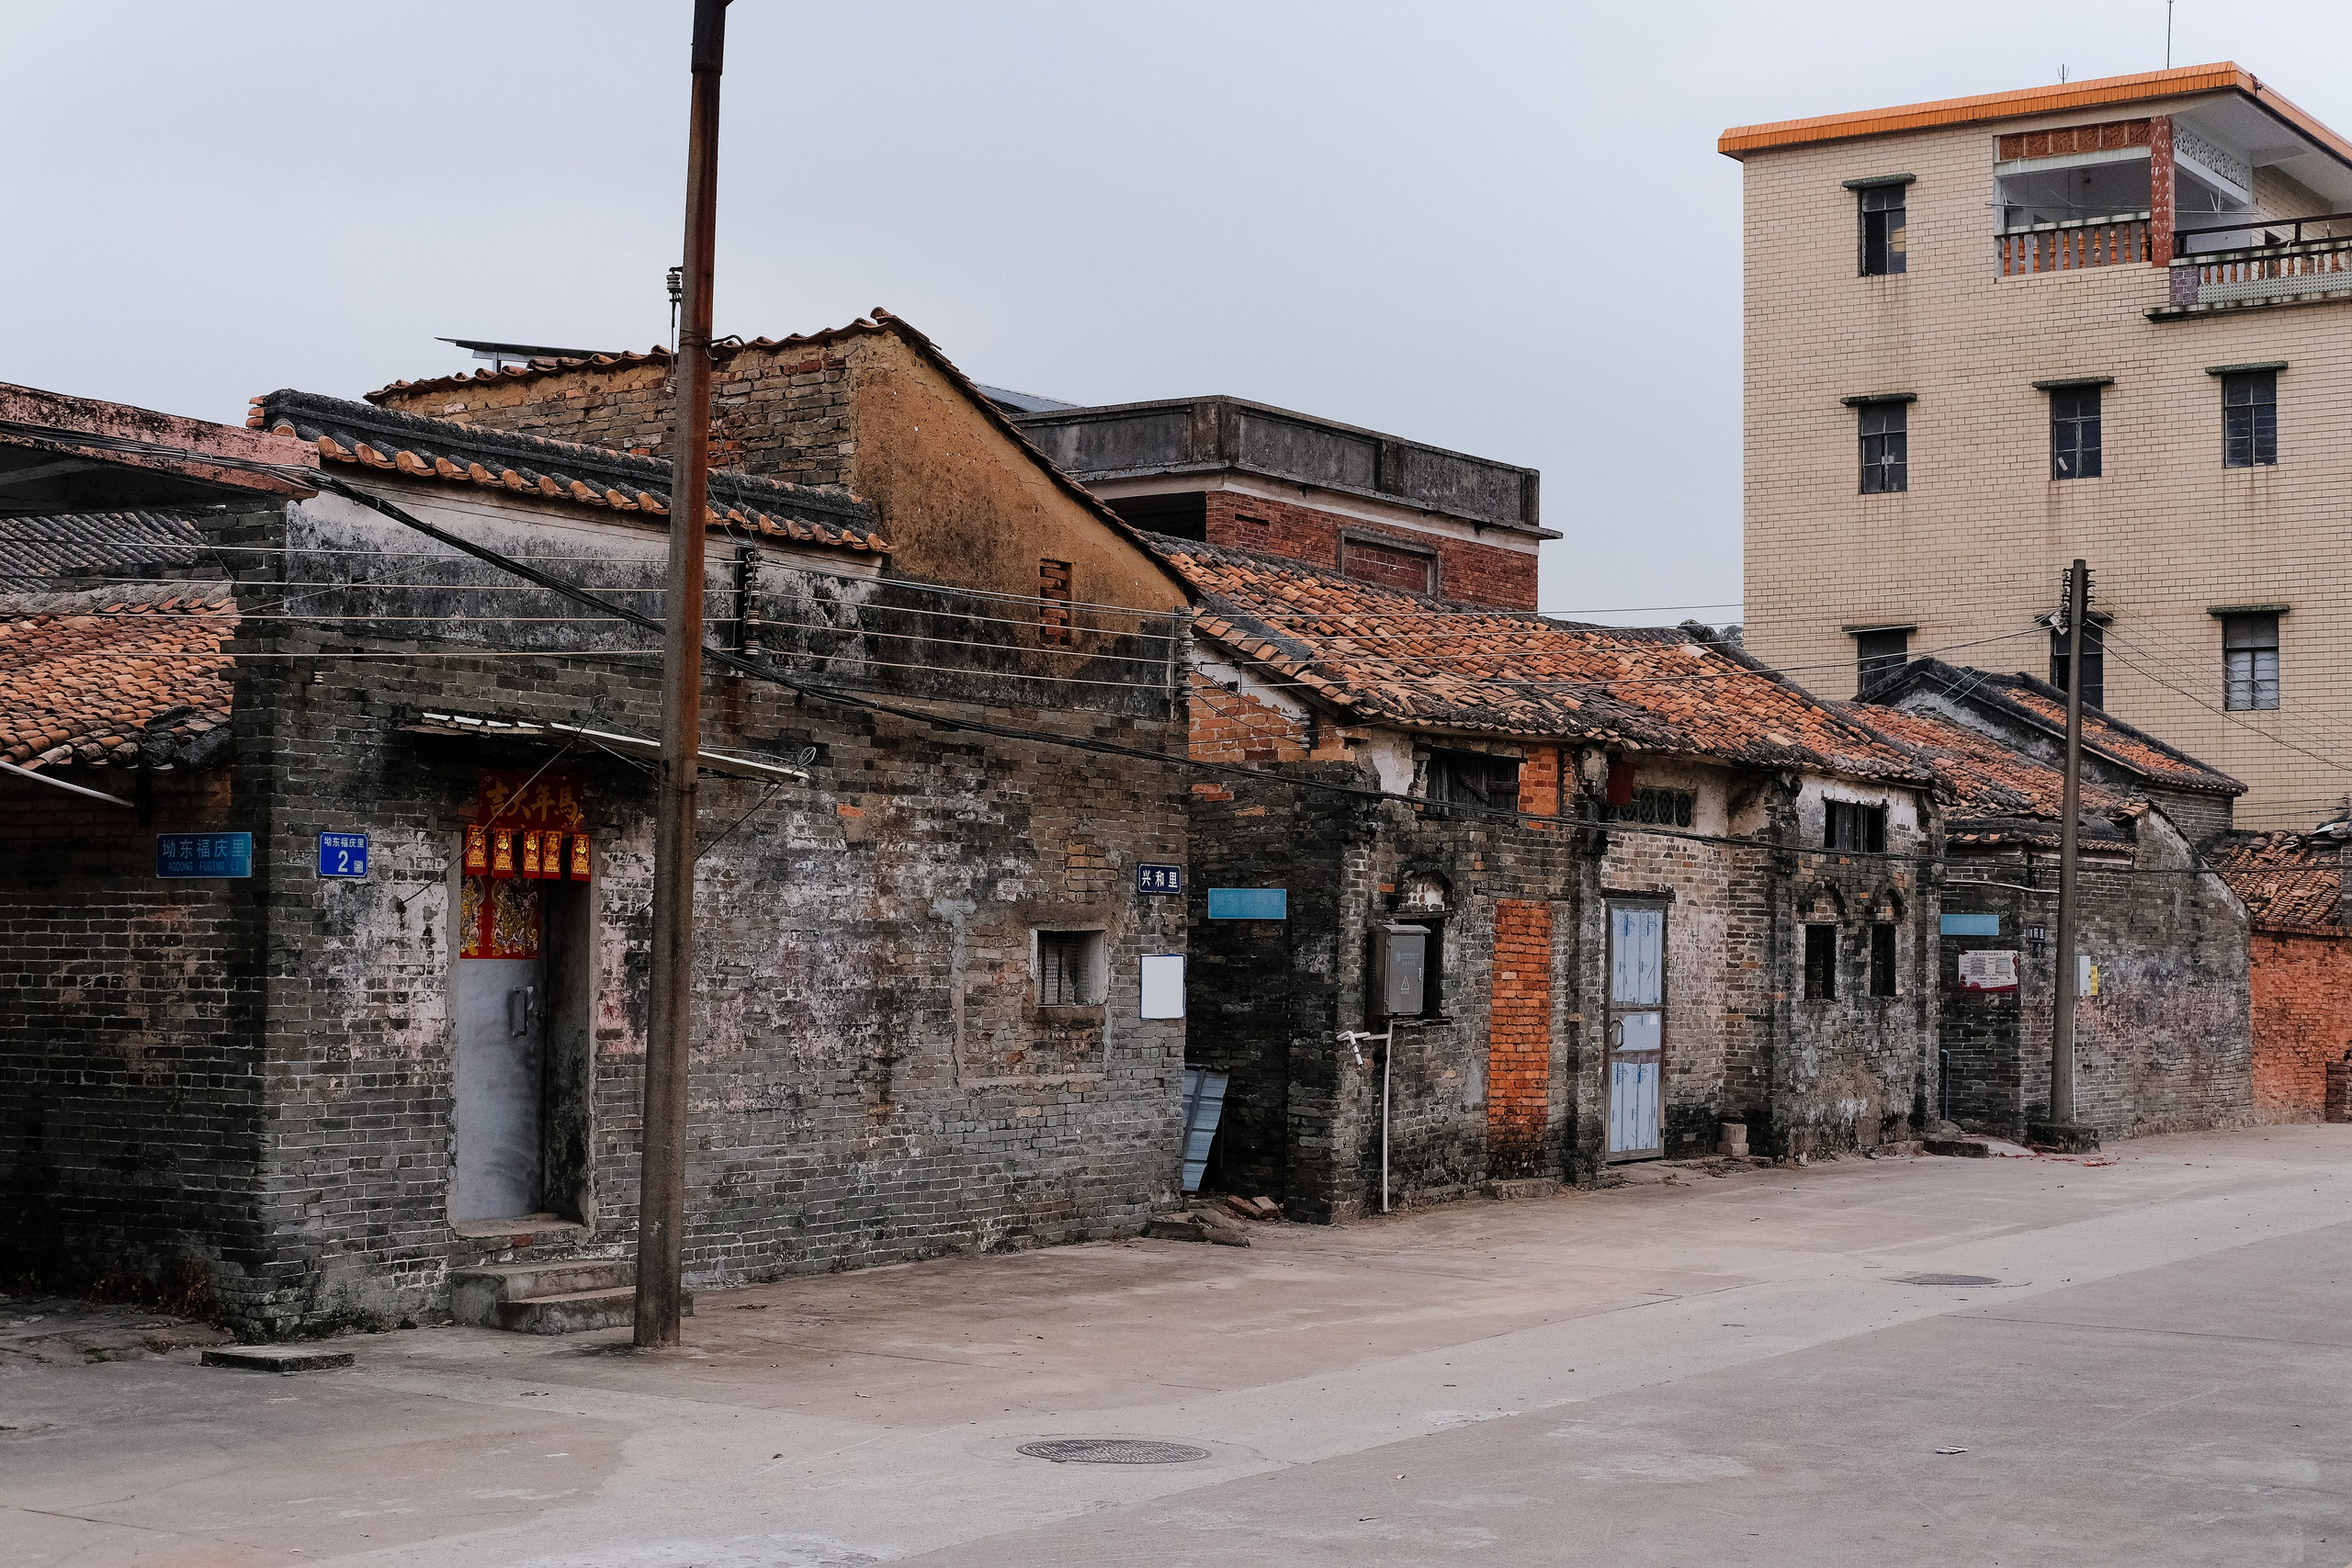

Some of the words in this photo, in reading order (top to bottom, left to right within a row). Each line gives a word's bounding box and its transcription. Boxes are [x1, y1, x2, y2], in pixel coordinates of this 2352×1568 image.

[162, 839, 245, 859] 坳东福庆里
[323, 836, 365, 848] 坳东福庆里
[337, 850, 349, 873] 2
[1141, 869, 1179, 888] 兴和里
